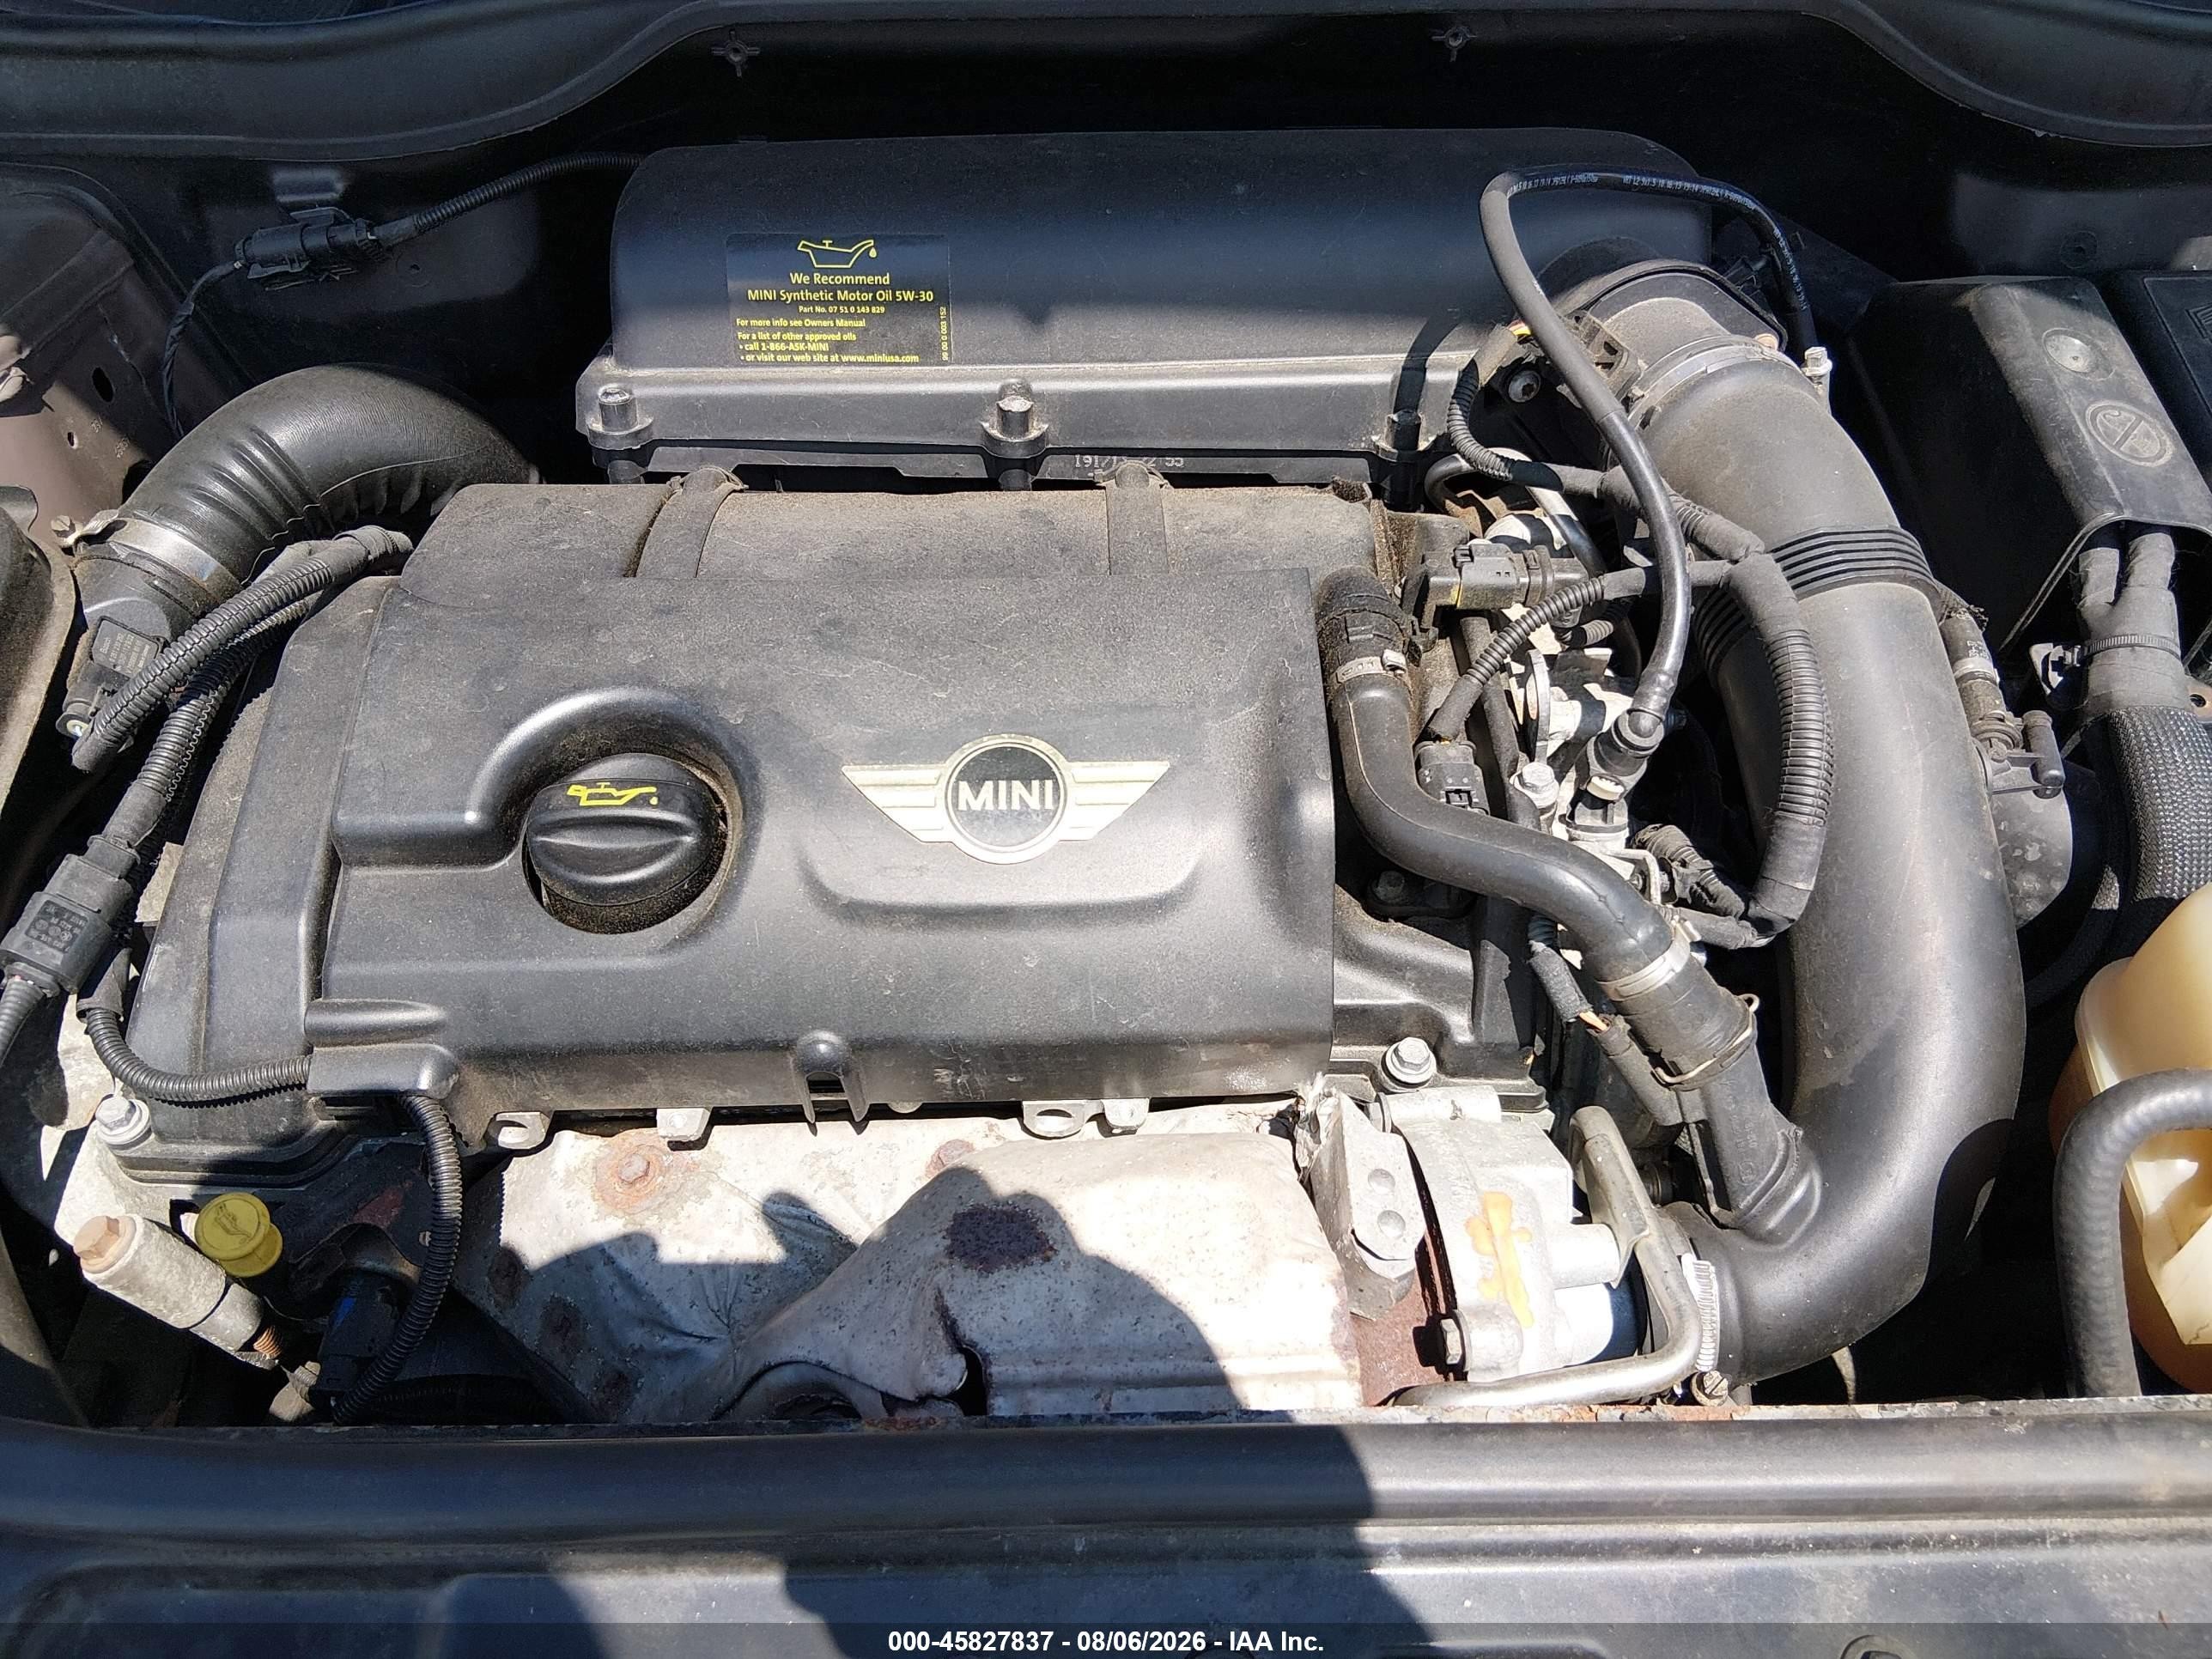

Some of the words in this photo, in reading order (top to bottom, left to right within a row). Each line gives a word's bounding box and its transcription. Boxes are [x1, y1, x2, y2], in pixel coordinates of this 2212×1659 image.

[789, 272, 811, 284] We
[813, 272, 890, 285] Recommend
[747, 289, 777, 301] MINI
[780, 289, 835, 304] Synthetic
[836, 289, 873, 301] Motor
[875, 289, 893, 301] Oil
[895, 290, 934, 302] 5W-30
[736, 318, 749, 326] For
[772, 318, 788, 326] info
[804, 319, 835, 327] Owners
[836, 318, 866, 327] Manual
[738, 331, 750, 340] For
[757, 331, 770, 340] list
[771, 331, 781, 340] of
[781, 331, 804, 341] other
[805, 331, 842, 342] approved
[842, 331, 857, 341] oils
[744, 343, 759, 351] call
[761, 343, 830, 351] 1-866-ASK-MINI
[757, 353, 775, 362] visit
[792, 353, 811, 362] web
[812, 353, 829, 362] site
[830, 353, 840, 362] at
[842, 353, 920, 363] www.miniusa.com
[958, 780, 1054, 811] MINI
